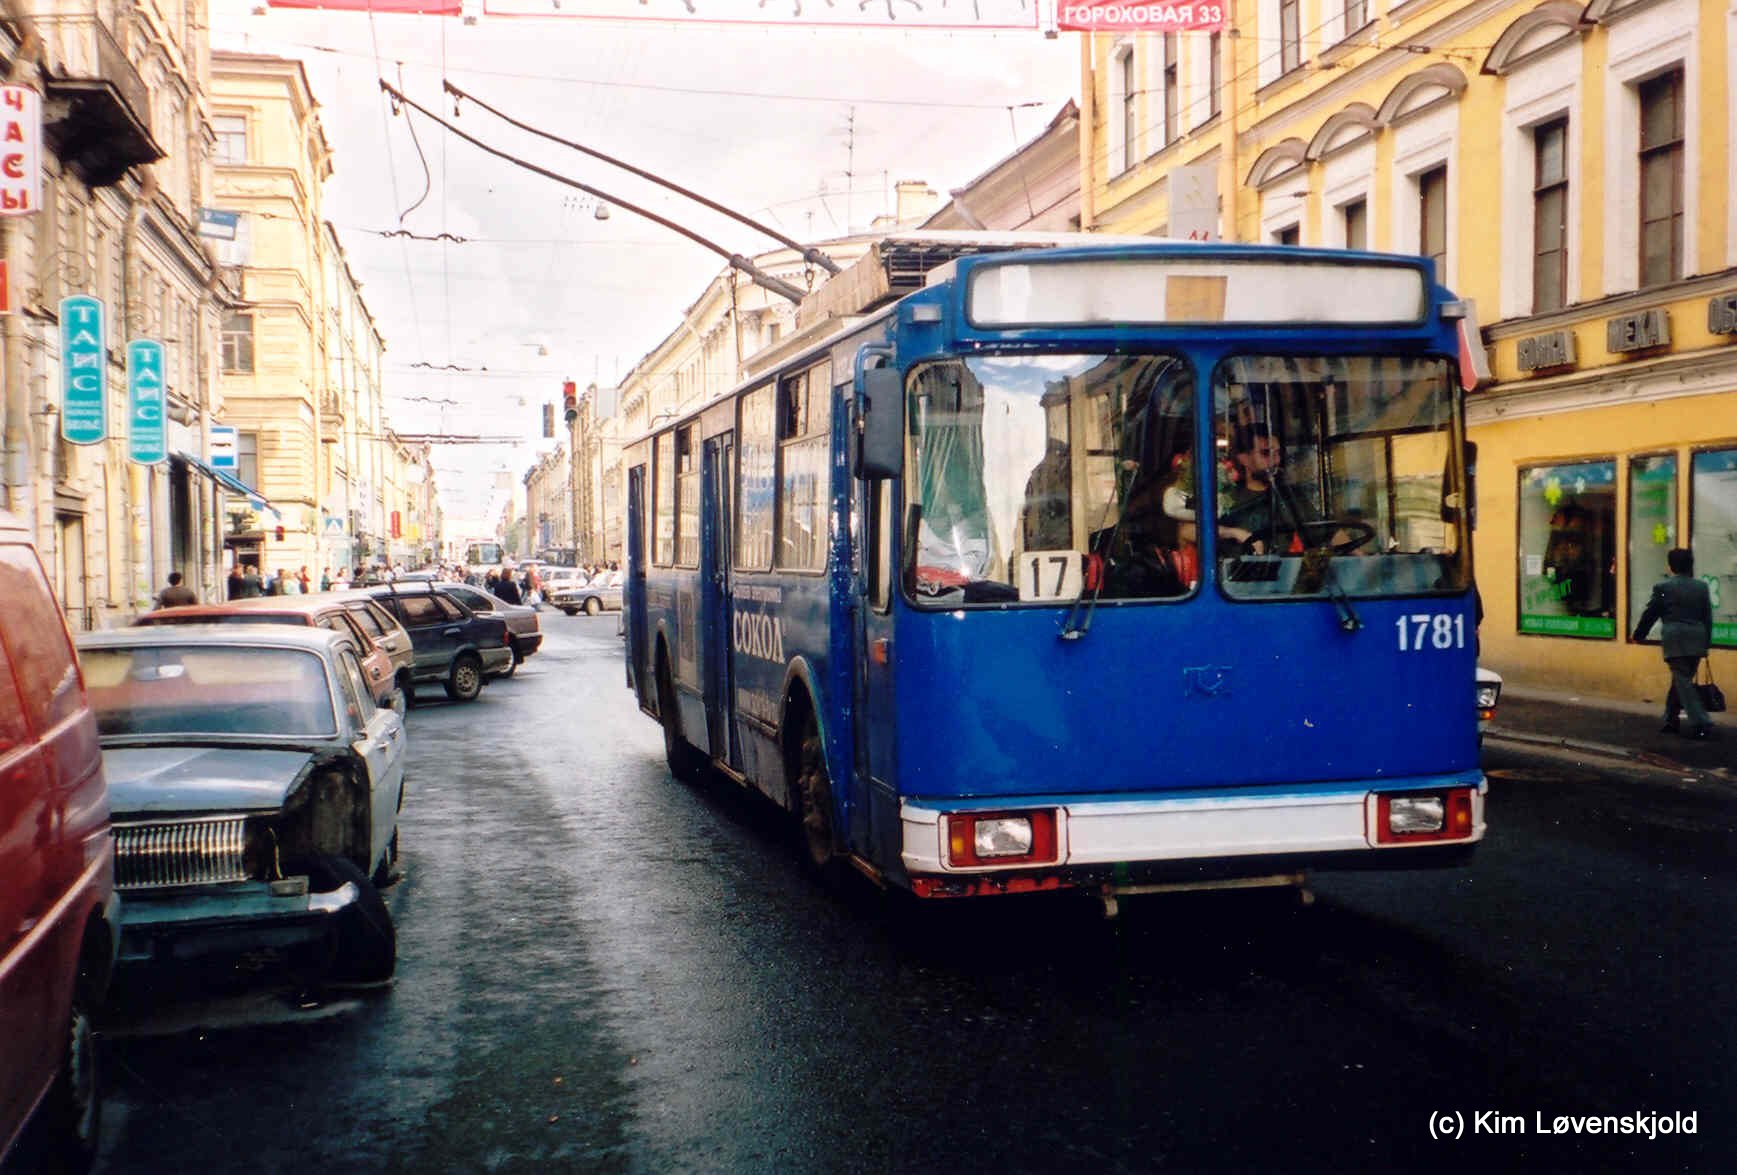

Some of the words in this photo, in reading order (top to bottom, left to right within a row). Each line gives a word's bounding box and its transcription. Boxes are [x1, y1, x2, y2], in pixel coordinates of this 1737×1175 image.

[1064, 5, 1193, 23] ГОРОХОВАЯ
[1199, 6, 1222, 23] 33
[0, 90, 28, 209] ЧАСЫ
[71, 305, 98, 392] ТАИС
[135, 347, 160, 421] ТАИС
[1030, 556, 1069, 598] 17
[1395, 613, 1465, 652] 1781
